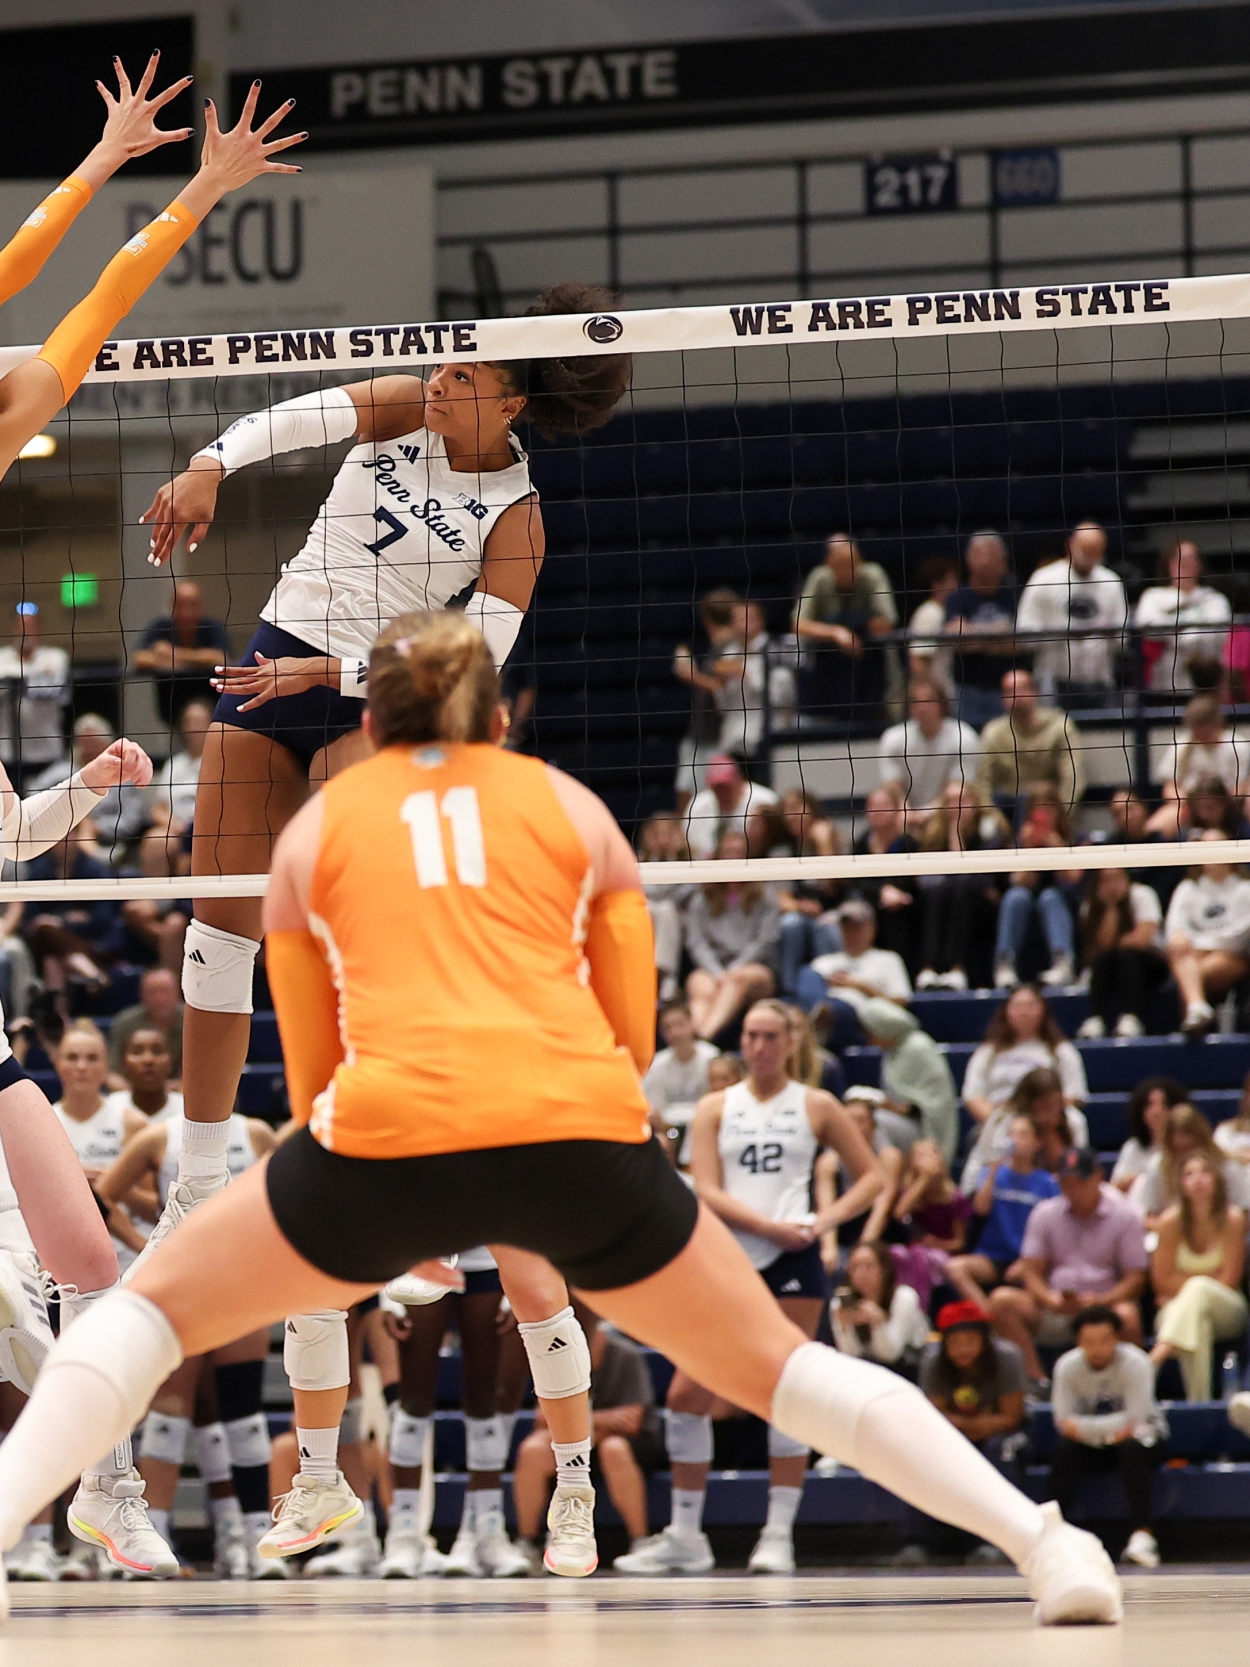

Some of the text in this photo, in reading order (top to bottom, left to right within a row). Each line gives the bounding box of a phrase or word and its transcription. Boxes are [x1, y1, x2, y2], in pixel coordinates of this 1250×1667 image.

[330, 49, 679, 119] PENN STATE
[873, 164, 948, 209] 217
[729, 281, 1171, 336] WE ARE PENN STATE
[87, 323, 477, 371] E ARE PENN STATE
[362, 454, 411, 503] Penn
[410, 498, 466, 552] State
[364, 505, 409, 557] 7
[399, 786, 488, 890] 11
[739, 1143, 783, 1174] 42
